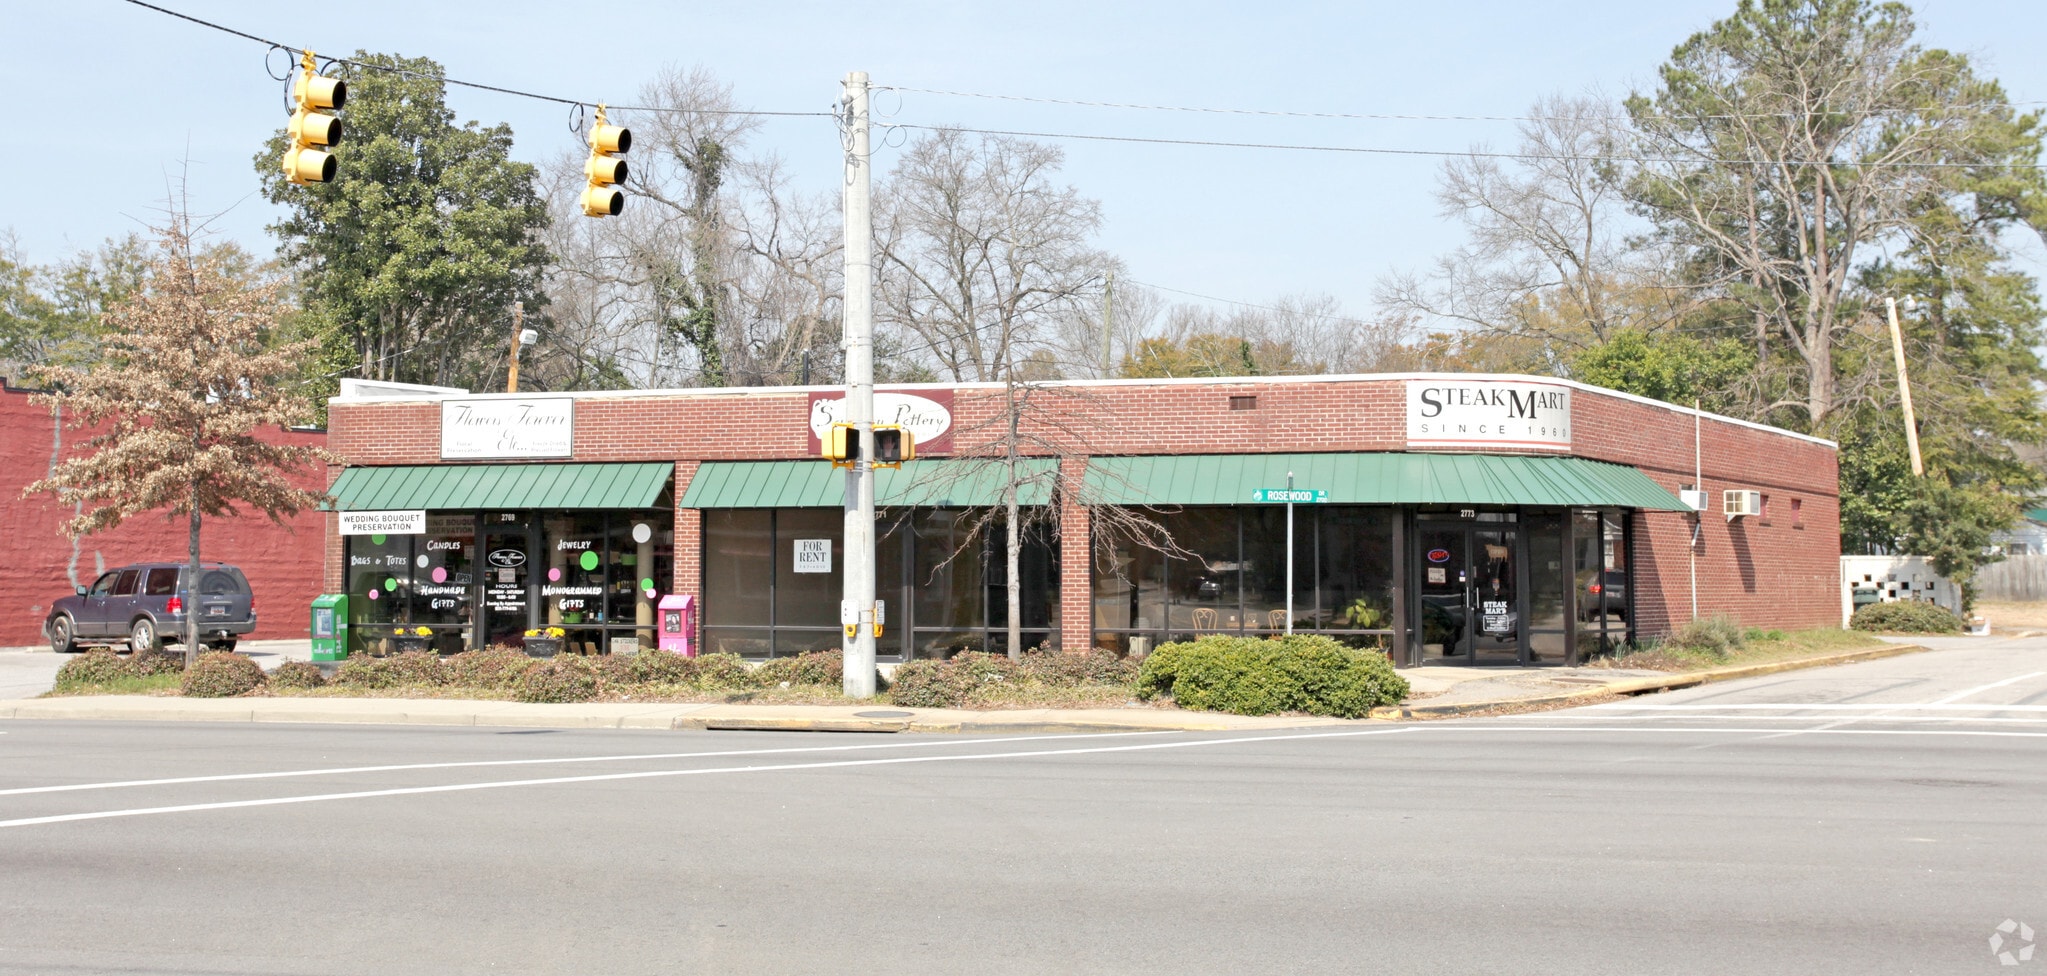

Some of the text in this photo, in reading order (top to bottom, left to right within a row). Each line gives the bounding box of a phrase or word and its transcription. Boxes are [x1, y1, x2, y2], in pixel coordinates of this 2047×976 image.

[1421, 388, 1566, 419] STEAK MART
[894, 403, 944, 433] Pottery
[1421, 424, 1567, 438] SINCE 1960
[1267, 490, 1312, 501] ROSEWOOD
[343, 514, 420, 523] WEDDING BOUQUET
[1460, 509, 1475, 518] 2773
[352, 523, 412, 531] PRESERVATION
[557, 539, 591, 551] JEWELRY
[803, 541, 822, 551] FOR
[385, 555, 407, 566] TOTES
[799, 552, 826, 562] RENT
[421, 585, 466, 596] HANDMADE
[542, 585, 602, 596] MONOGRAMMED
[431, 598, 456, 609] GIFTS
[559, 598, 585, 610] GIFTS
